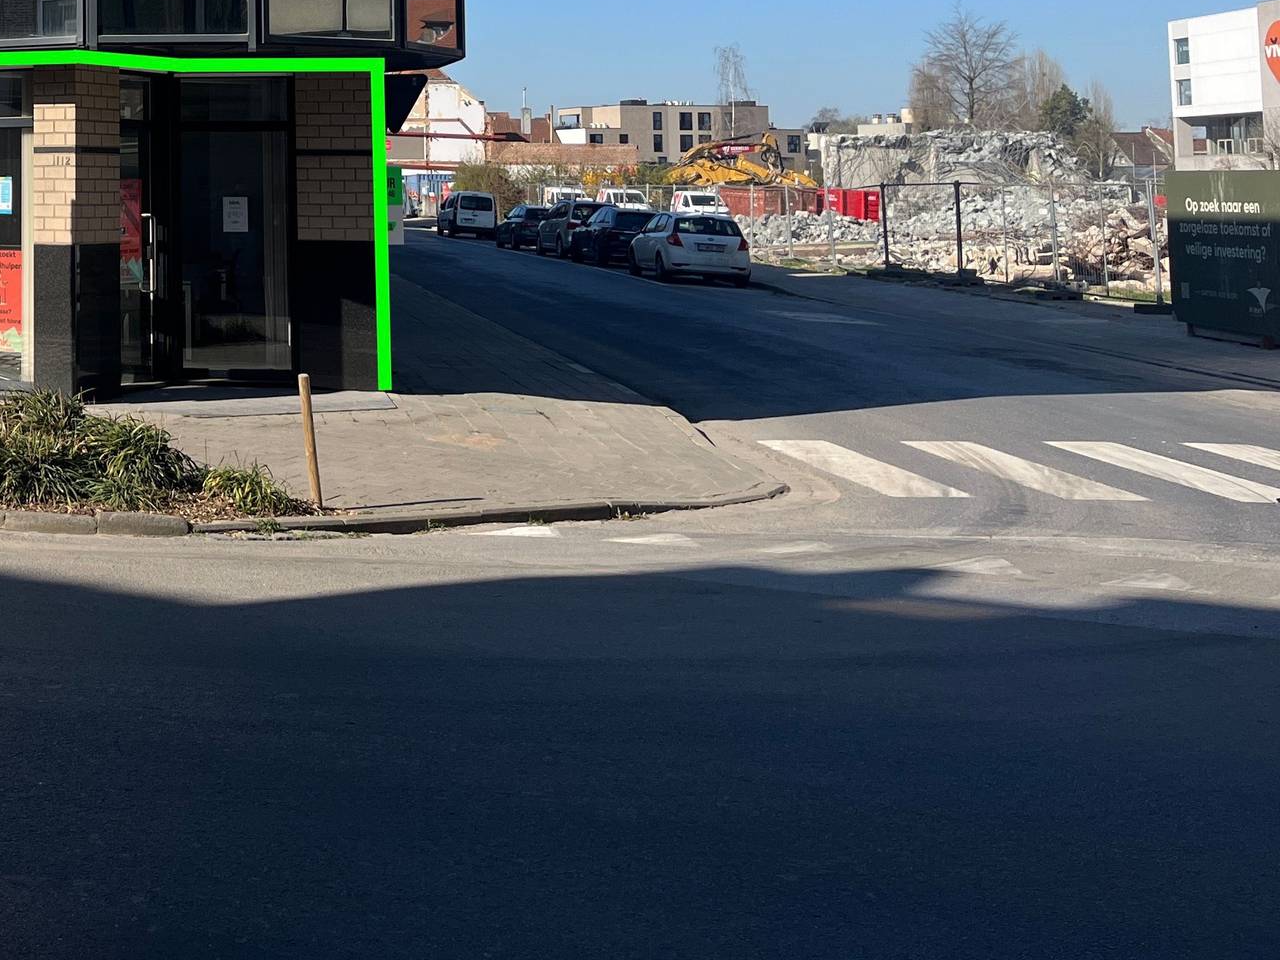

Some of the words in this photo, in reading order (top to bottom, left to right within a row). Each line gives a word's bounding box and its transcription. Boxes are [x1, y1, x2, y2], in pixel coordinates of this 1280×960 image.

[1185, 197, 1199, 215] Op
[1200, 198, 1220, 213] zoek
[1221, 202, 1242, 213] naar
[1244, 202, 1260, 213] een
[1179, 220, 1218, 236] zorgeloze
[1220, 220, 1260, 236] toekomst
[1261, 222, 1271, 237] of
[1185, 241, 1213, 259] veilige
[1214, 243, 1266, 263] investering?
